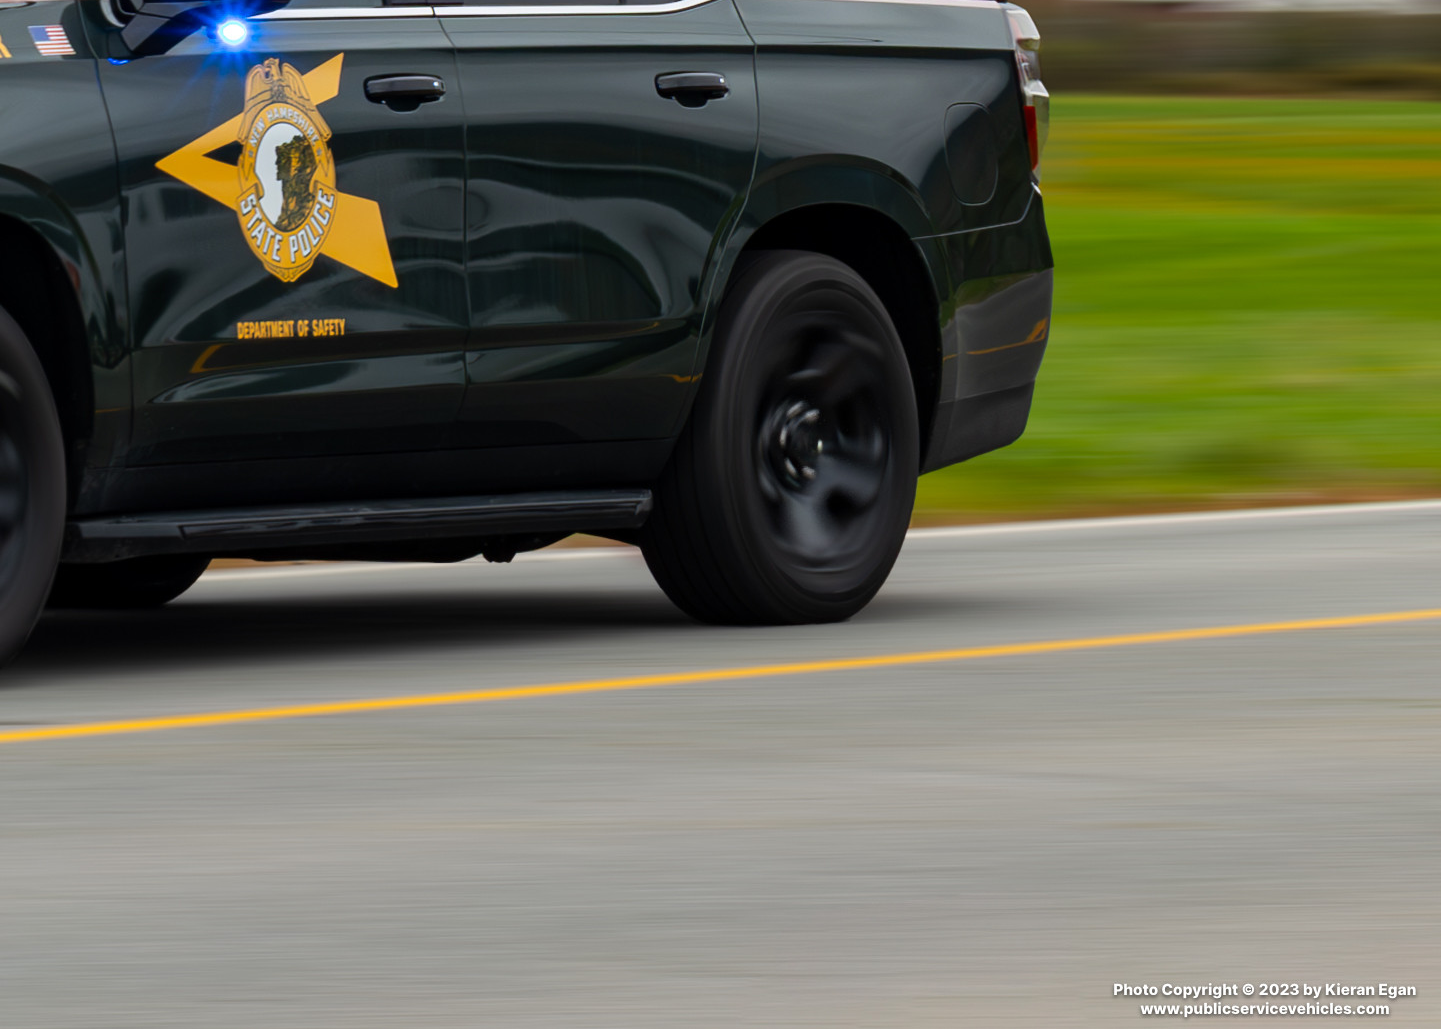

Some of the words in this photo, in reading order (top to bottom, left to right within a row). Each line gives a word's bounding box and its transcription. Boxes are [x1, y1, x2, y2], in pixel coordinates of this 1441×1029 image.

[248, 118, 267, 148] NEW
[266, 107, 321, 148] HAMPSHIRE
[239, 192, 285, 264] STATE
[288, 188, 336, 264] POLICE
[236, 320, 294, 340] DEPARTMENT
[297, 319, 310, 338] OF
[312, 318, 346, 337] SAFETY
